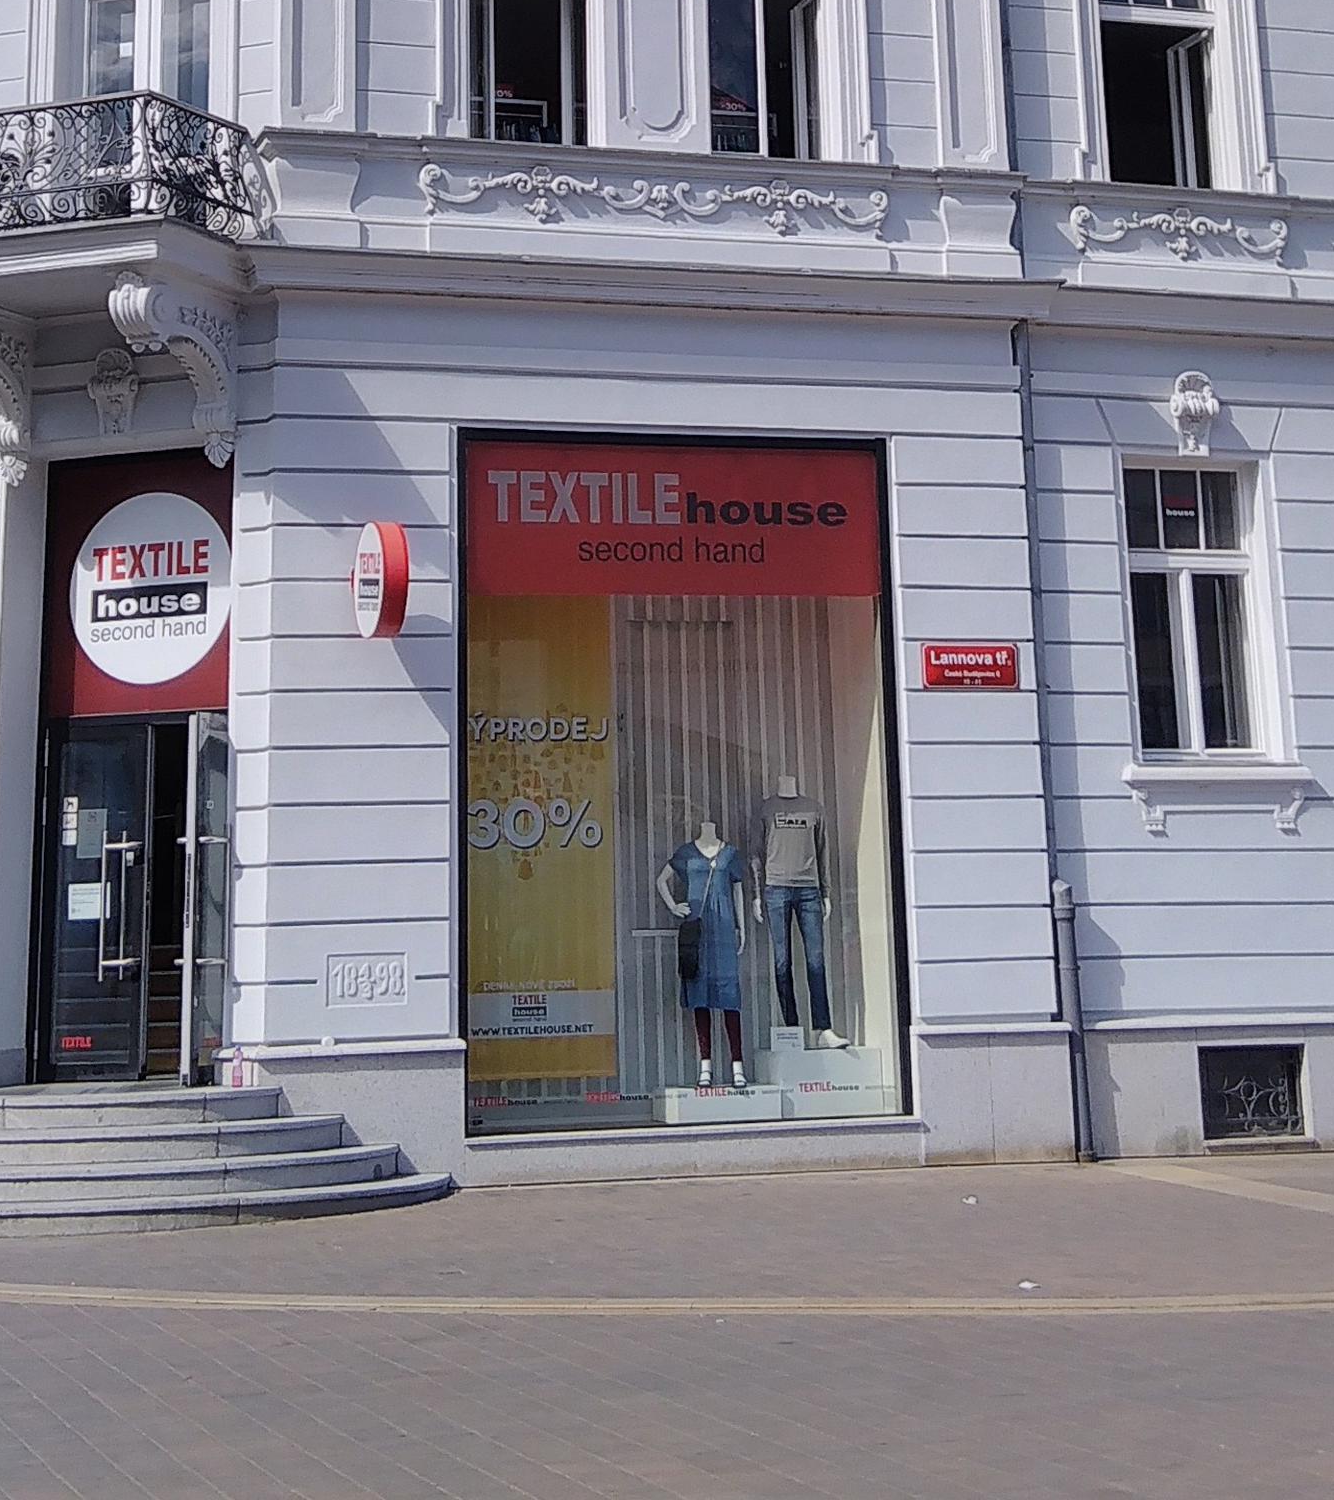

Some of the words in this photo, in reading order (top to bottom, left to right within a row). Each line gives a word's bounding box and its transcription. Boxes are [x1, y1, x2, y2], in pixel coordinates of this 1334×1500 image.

[92, 538, 211, 583] TEXTILE
[577, 537, 684, 563] second
[694, 537, 766, 564] hand
[359, 581, 379, 596] house
[96, 590, 203, 618] house
[90, 620, 156, 643] second
[161, 616, 208, 638] hand
[930, 651, 994, 665] Lannova
[996, 650, 1012, 666] tř.
[468, 797, 604, 849] 30%
[512, 994, 547, 1005] TEXTILE
[514, 1008, 545, 1016] house
[471, 1024, 594, 1036] WWW.TEXTILEHOUSE.NET
